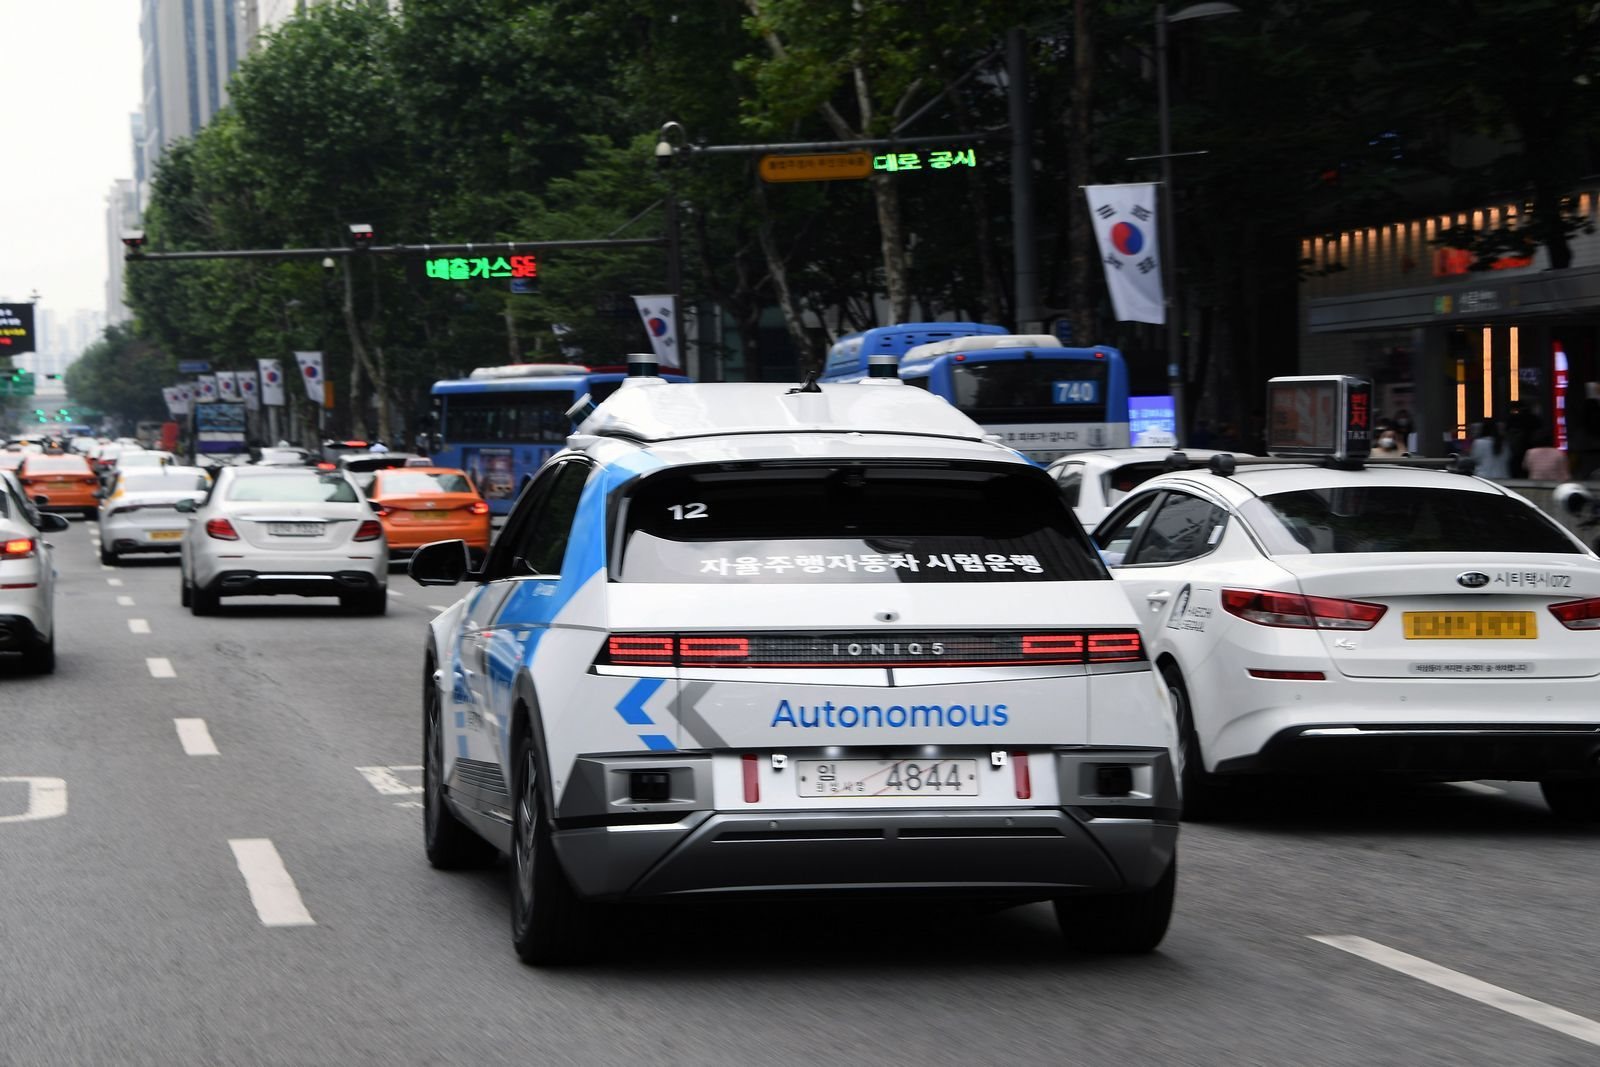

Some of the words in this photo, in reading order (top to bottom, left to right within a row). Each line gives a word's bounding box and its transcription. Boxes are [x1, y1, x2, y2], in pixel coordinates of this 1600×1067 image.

[873, 153, 922, 172] 대로
[1058, 383, 1094, 402] 740
[667, 502, 709, 520] 12
[700, 553, 920, 576] 자율주행자동차
[926, 553, 1044, 574] 시험운행
[771, 699, 1010, 729] Autonomous
[816, 764, 836, 781] 임
[886, 763, 962, 791] 4844
